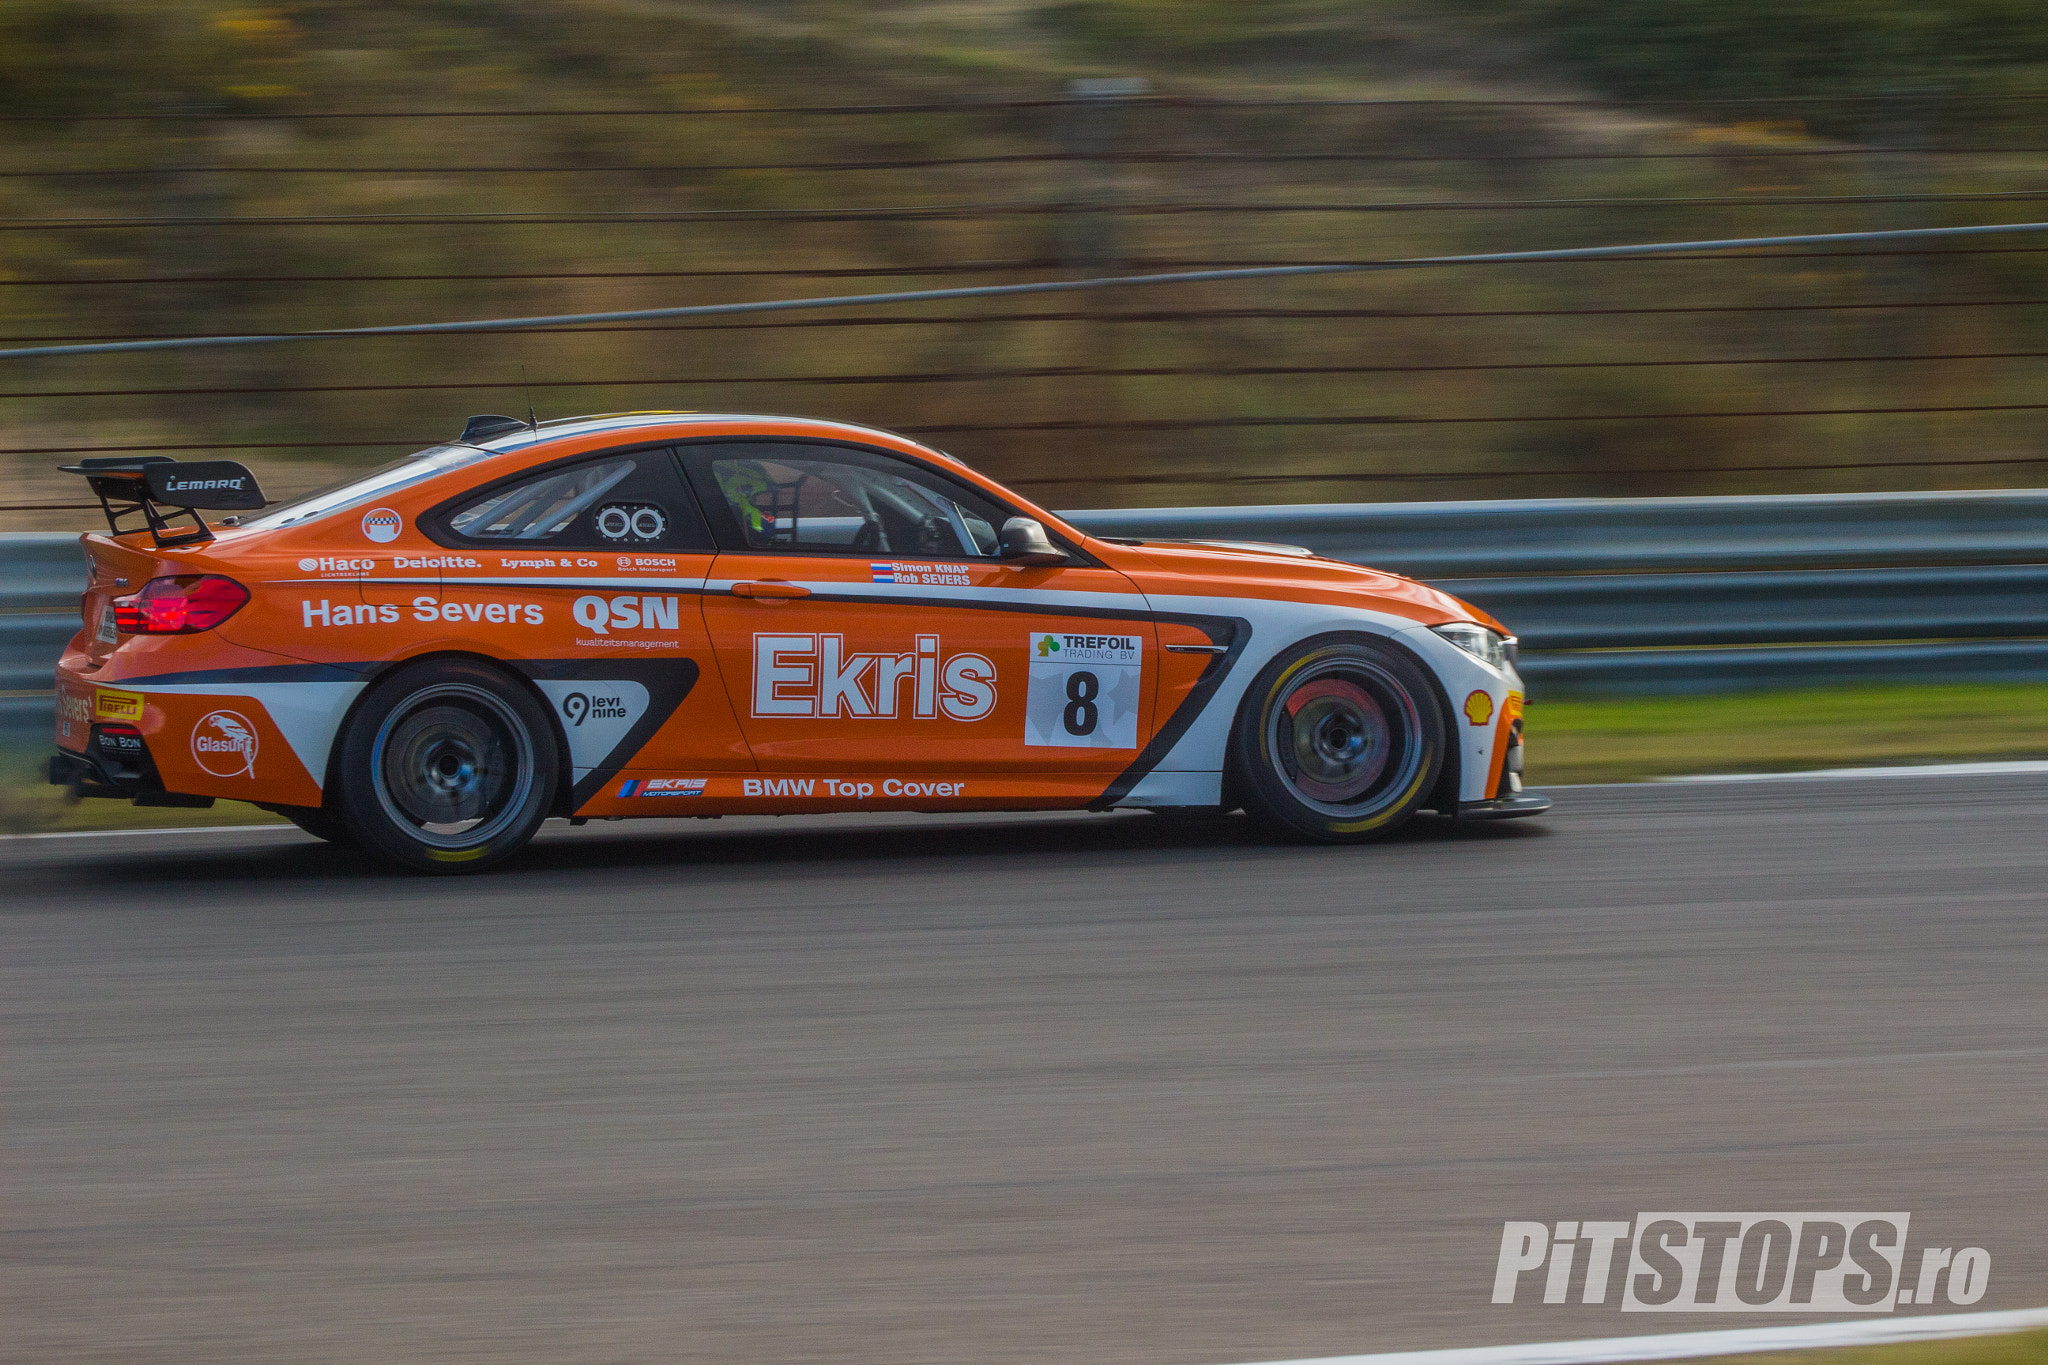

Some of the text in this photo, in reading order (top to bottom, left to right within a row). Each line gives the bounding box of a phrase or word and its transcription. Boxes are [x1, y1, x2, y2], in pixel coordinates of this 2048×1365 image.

[166, 479, 242, 492] LEMARQ
[319, 557, 375, 571] Haco
[394, 556, 482, 569] Deloitte.
[501, 558, 598, 569] Lymph & Co
[635, 558, 676, 567] BOSCH
[891, 562, 969, 574] Simon KNAP
[894, 572, 971, 585] Rob SEVERS
[302, 596, 544, 628] Hans Severs
[572, 595, 680, 635] QSN
[575, 637, 680, 650] kwaliteitsmanagement
[1063, 635, 1135, 650] TREFOIL
[1063, 649, 1135, 660] TRADING BV
[751, 632, 997, 722] Ekris
[99, 694, 137, 715] PIRELLI
[592, 696, 620, 707] levi
[1063, 670, 1099, 736] 8
[592, 707, 626, 718] nine
[743, 779, 964, 799] BMW Top Cover
